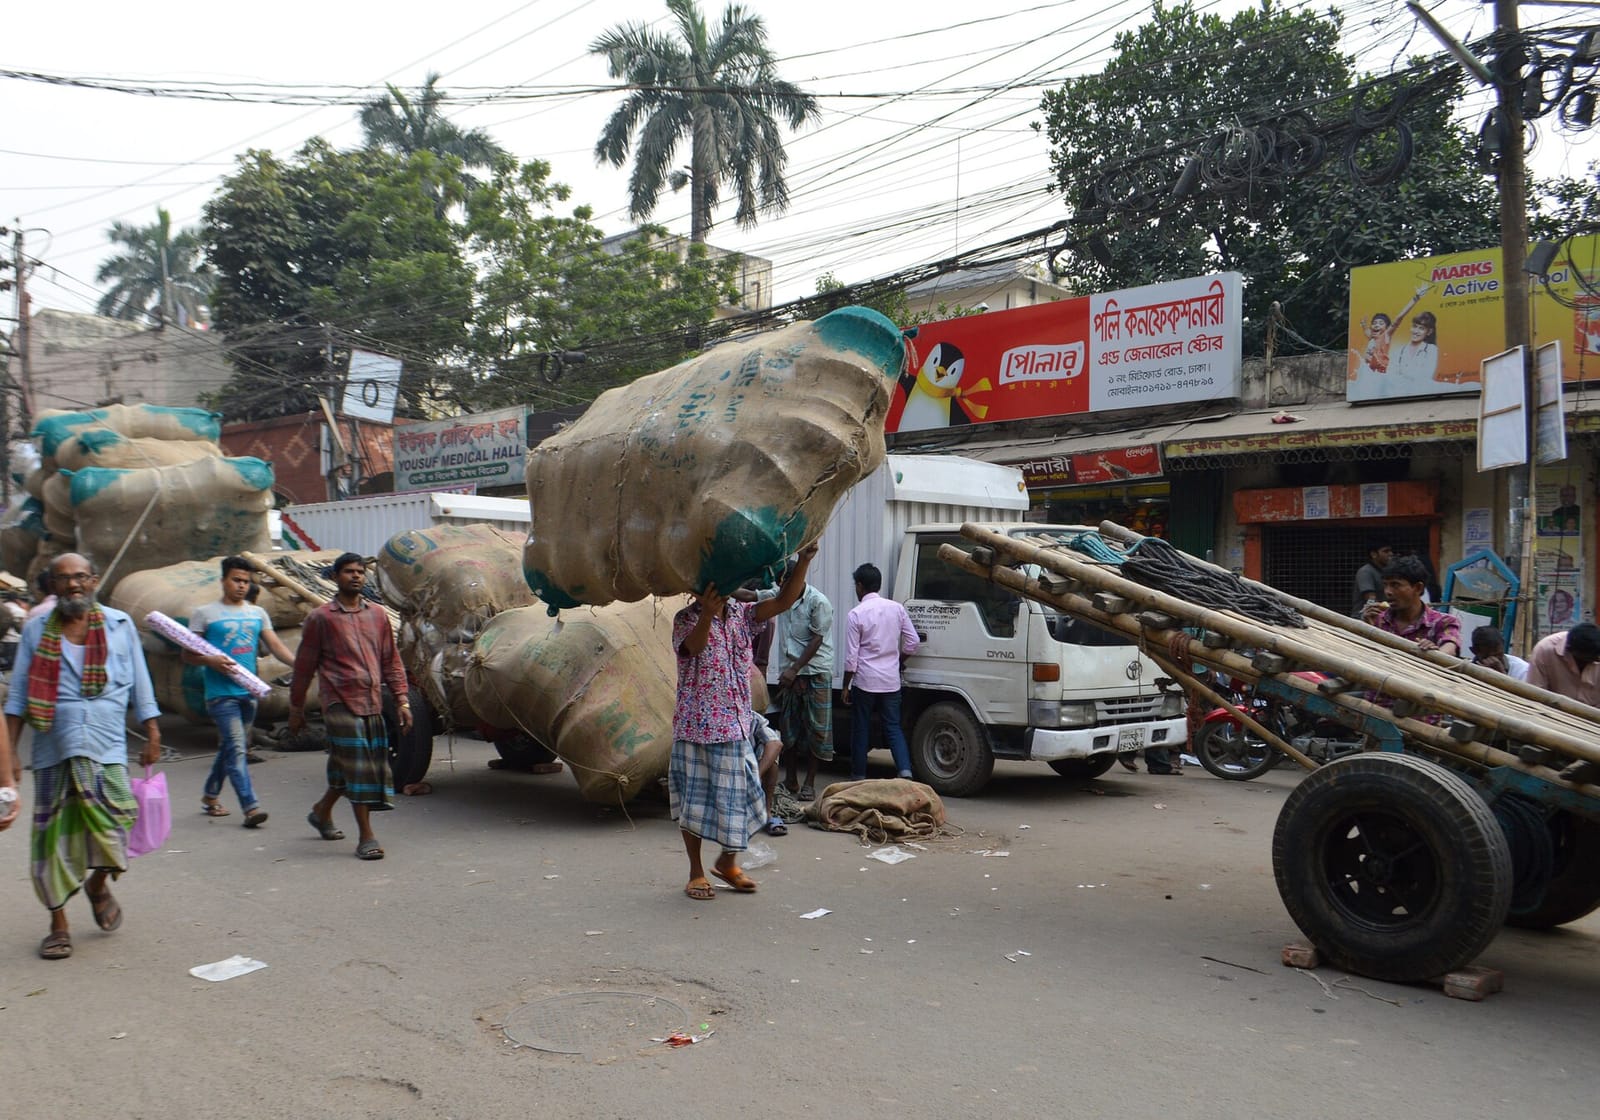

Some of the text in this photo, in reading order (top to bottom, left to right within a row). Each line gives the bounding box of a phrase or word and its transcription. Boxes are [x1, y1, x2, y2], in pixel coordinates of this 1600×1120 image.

[1432, 261, 1493, 281] MARKS
[1443, 278, 1499, 297] Active
[1094, 299, 1121, 342] পলি
[1124, 341, 1183, 363] জেনারেল
[1005, 350, 1077, 378] পোলার
[1115, 373, 1127, 384] নং
[398, 444, 522, 472] YOUSUF MEDICAL HALL
[222, 621, 257, 647] 75
[987, 650, 1015, 659] DYNA
